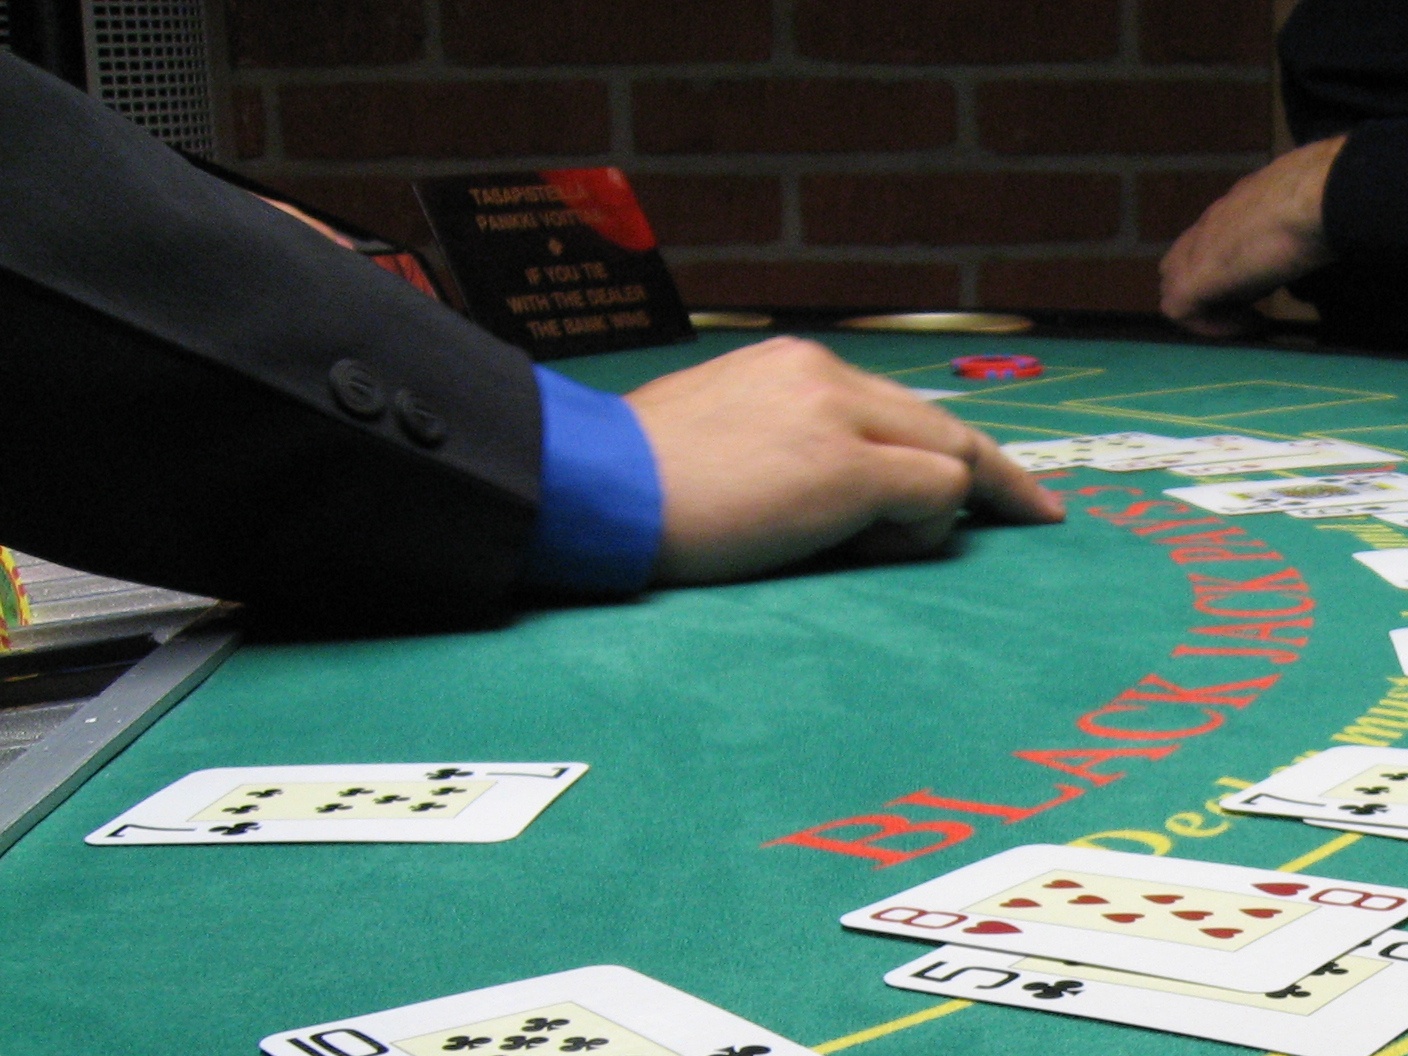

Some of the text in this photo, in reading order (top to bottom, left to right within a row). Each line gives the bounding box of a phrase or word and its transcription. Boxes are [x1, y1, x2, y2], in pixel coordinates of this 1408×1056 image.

[525, 262, 608, 285] IF YOU TIE
[507, 284, 649, 314] WITH THE DEALER
[527, 319, 562, 339] THE
[1087, 499, 1284, 566] PAYS
[1170, 566, 1317, 666] JACK
[486, 766, 569, 779] 7
[760, 672, 1282, 871] BLACK
[1240, 792, 1328, 808] 7
[106, 823, 197, 838] 7
[1309, 887, 1408, 912] 8
[870, 906, 969, 930] 8
[910, 959, 1021, 990] 5
